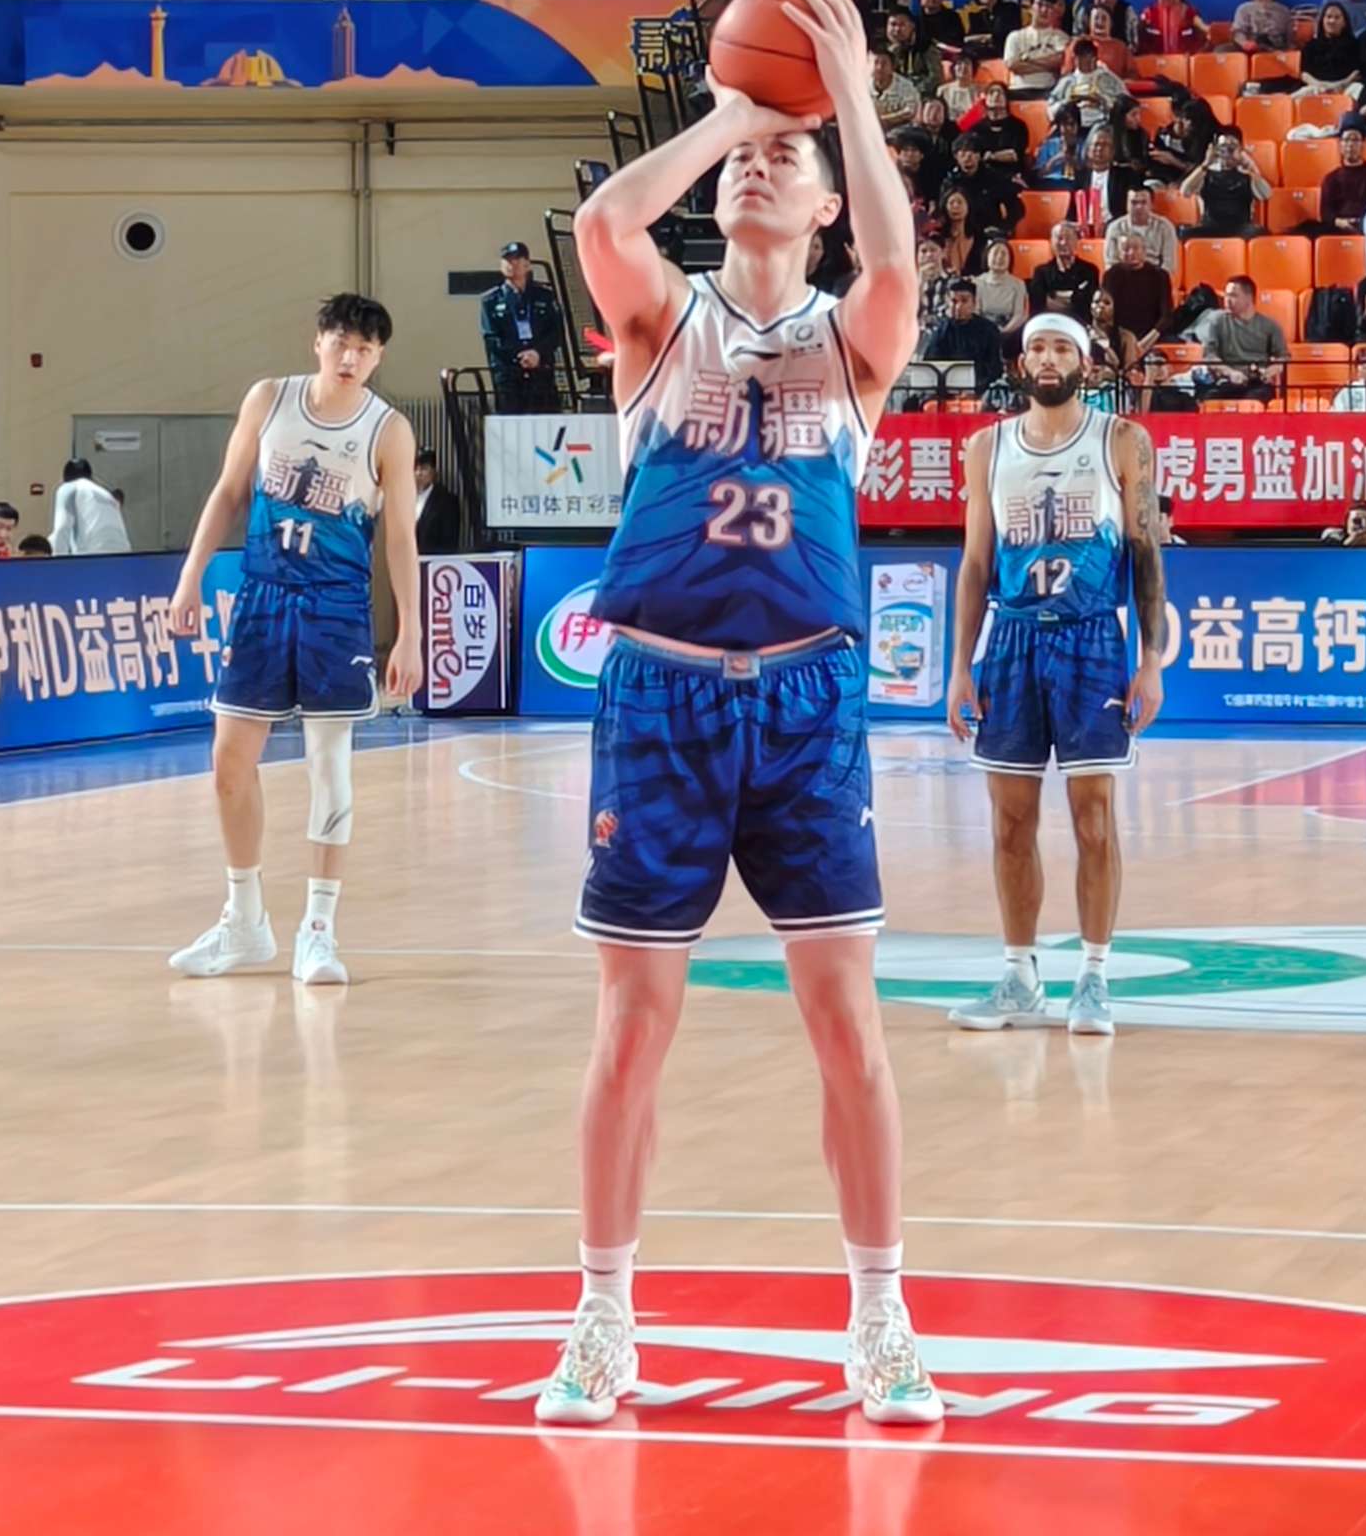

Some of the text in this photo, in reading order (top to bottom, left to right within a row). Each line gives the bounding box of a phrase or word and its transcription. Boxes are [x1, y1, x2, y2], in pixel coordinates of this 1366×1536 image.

[683, 368, 828, 461] 新疆
[262, 450, 353, 517] 新疆
[277, 519, 313, 557] 11
[705, 481, 792, 552] 23
[1005, 490, 1096, 547] 新疆
[1029, 556, 1073, 596] 12
[463, 583, 489, 671] 百岁山
[559, 610, 616, 654] 伊
